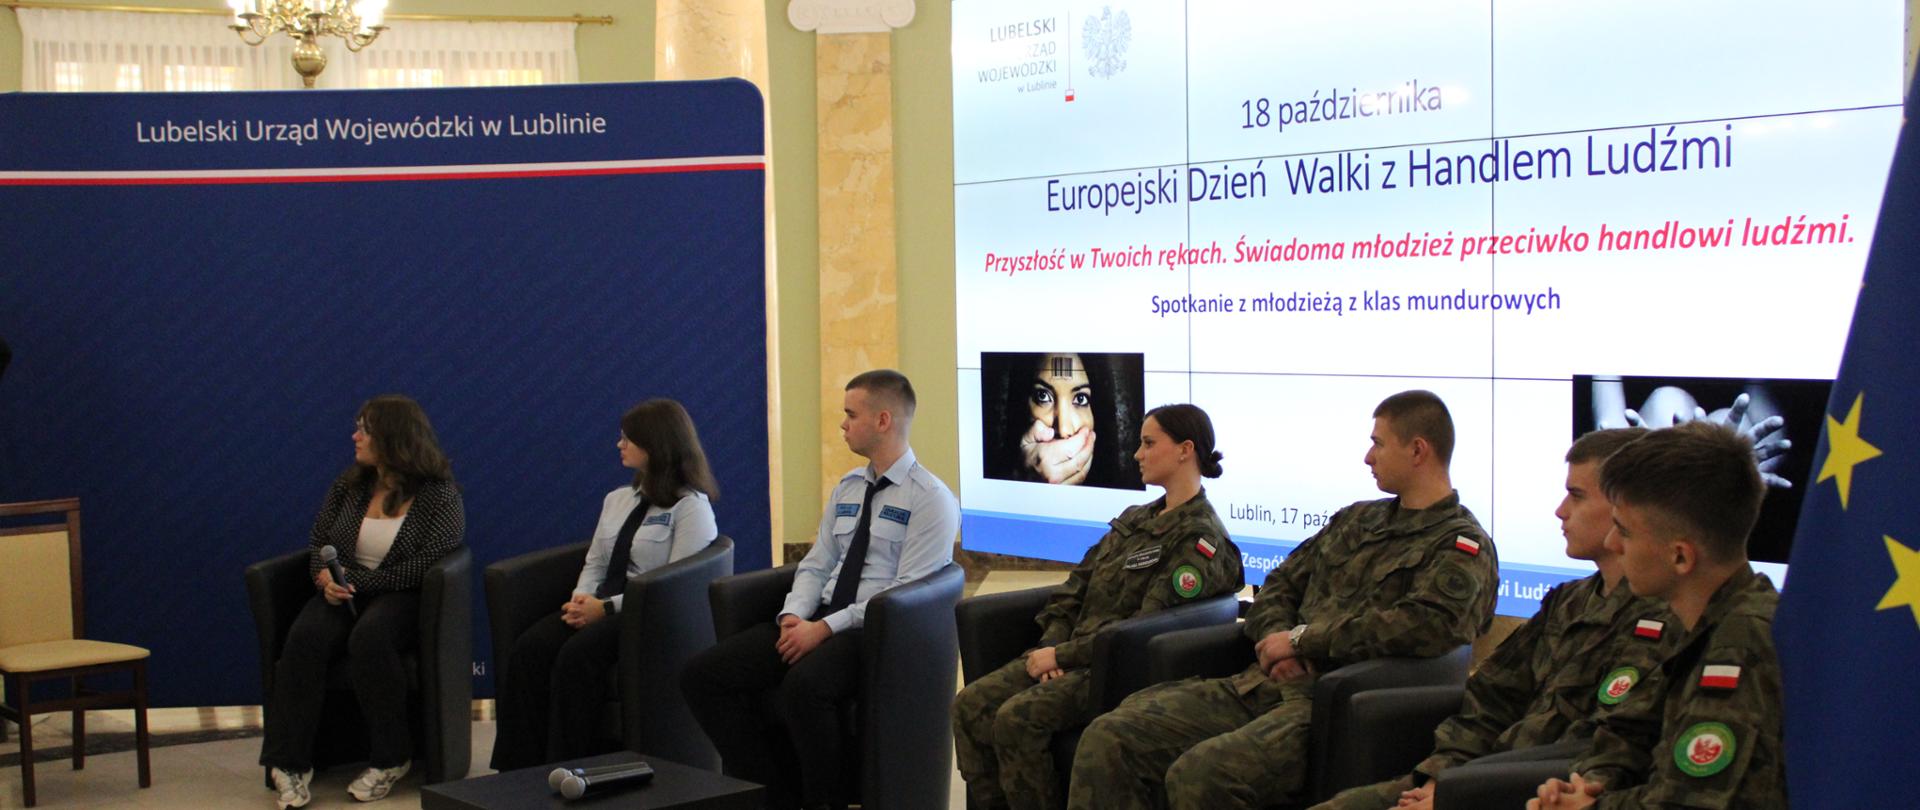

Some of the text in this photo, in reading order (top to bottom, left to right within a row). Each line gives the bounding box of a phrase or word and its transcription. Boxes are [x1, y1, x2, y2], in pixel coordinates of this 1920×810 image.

[990, 16, 1056, 43] LUBELSKI
[1017, 85, 1025, 94] w
[1241, 79, 1442, 132] 18 października
[136, 112, 606, 146] Lubelski Urząd Wojewódzki w Lublinie
[1047, 124, 1732, 215] Europejski Dzień Walki z Handlem Ludźmi
[985, 213, 1854, 276] Przyszłość w Twoich rękach. Świadoma młodzież przeciwko handlowi ludźmi.
[1151, 288, 1561, 318] Spotkanie z młodzieżą z klas mundurowych
[1230, 503, 1329, 530] Lublin, 17 paź
[472, 661, 486, 676] ki
